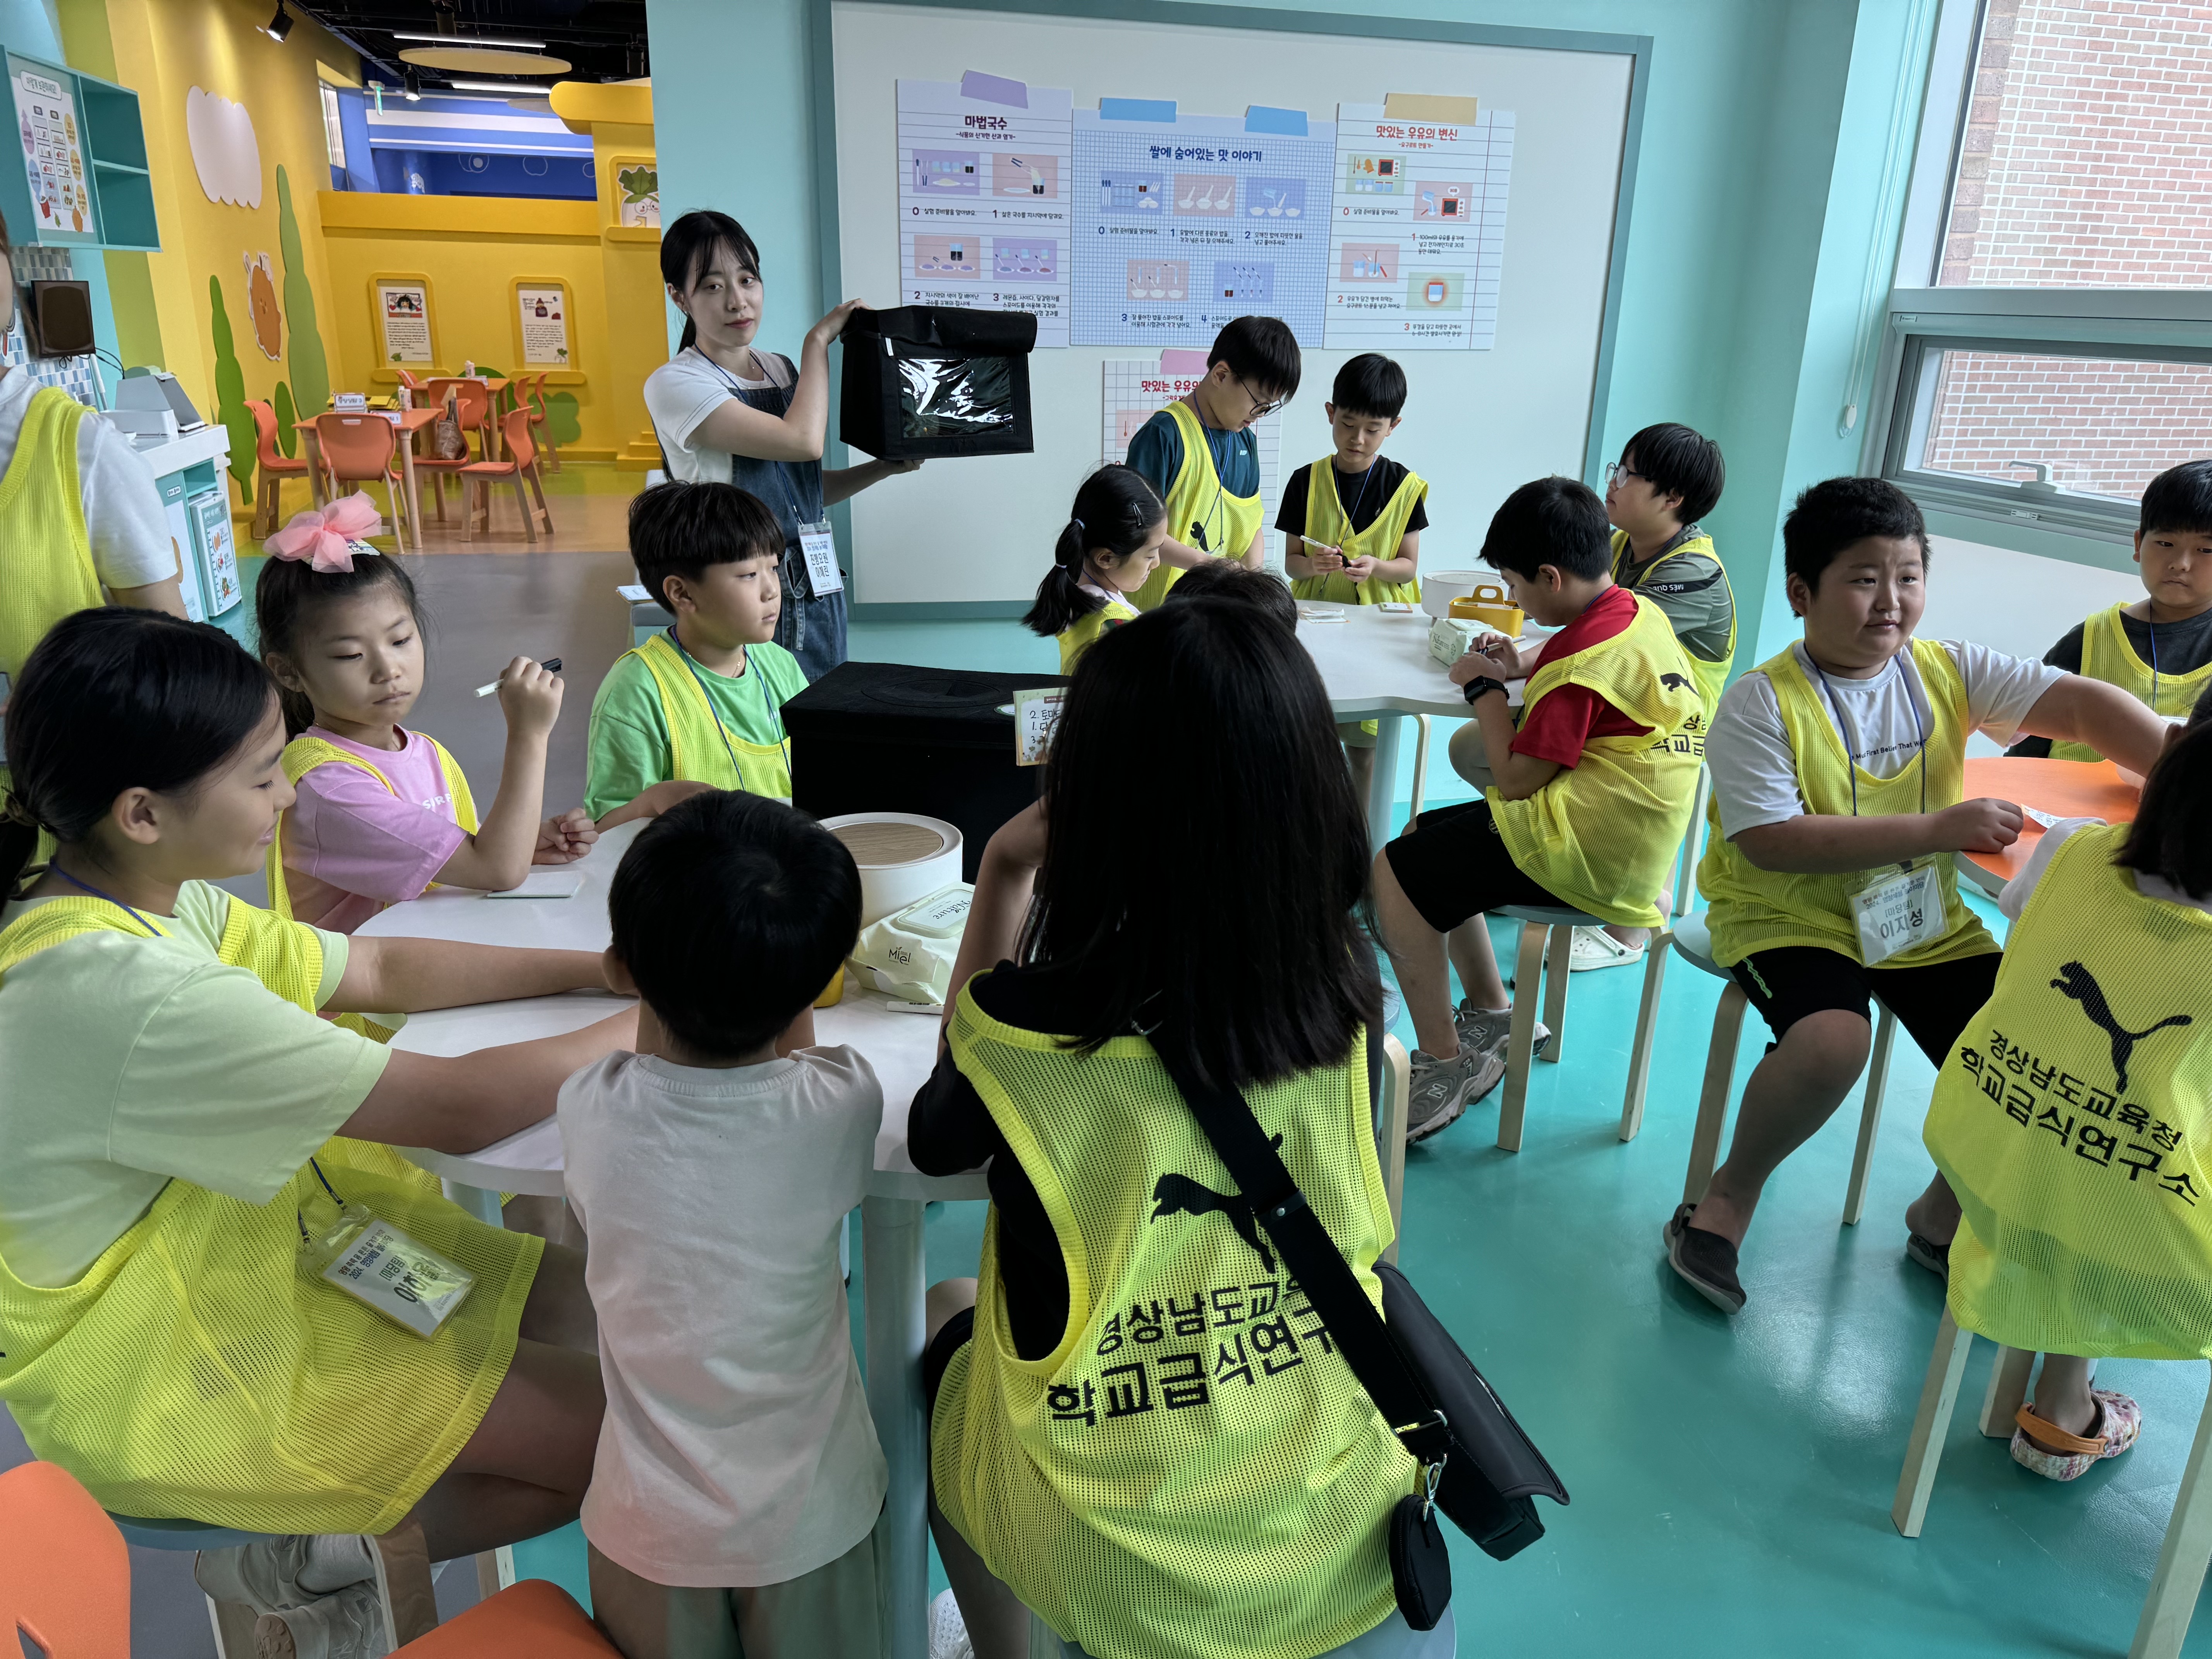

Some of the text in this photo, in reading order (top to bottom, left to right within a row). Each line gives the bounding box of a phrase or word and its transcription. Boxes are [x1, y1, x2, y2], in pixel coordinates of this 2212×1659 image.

[965, 116, 1007, 130] 마법국수
[1376, 125, 1458, 141] 맛있는 우유의 변신
[1149, 145, 1262, 162] 쌀에 숨어있는 맛 이야기
[913, 207, 919, 215] 0
[993, 210, 997, 218] 1
[1343, 207, 1349, 216] 0
[1098, 226, 1105, 235] 0
[1170, 228, 1175, 237] 1
[914, 291, 921, 299] 2
[993, 293, 999, 301] 3
[1338, 295, 1343, 303] 2
[1121, 313, 1127, 321] 3
[1404, 323, 1410, 331] 3
[1142, 381, 1170, 392] 맛있는
[810, 552, 829, 565] 진행요원
[1866, 901, 1881, 909] 2024.
[1880, 908, 1924, 939] 이지성
[889, 947, 911, 964] Miel
[1990, 1029, 2183, 1152] 경상남도교육청
[1961, 1046, 2200, 1207] 학교급식연구소
[350, 1267, 365, 1279] 2024.
[361, 1250, 381, 1267] 영양체험
